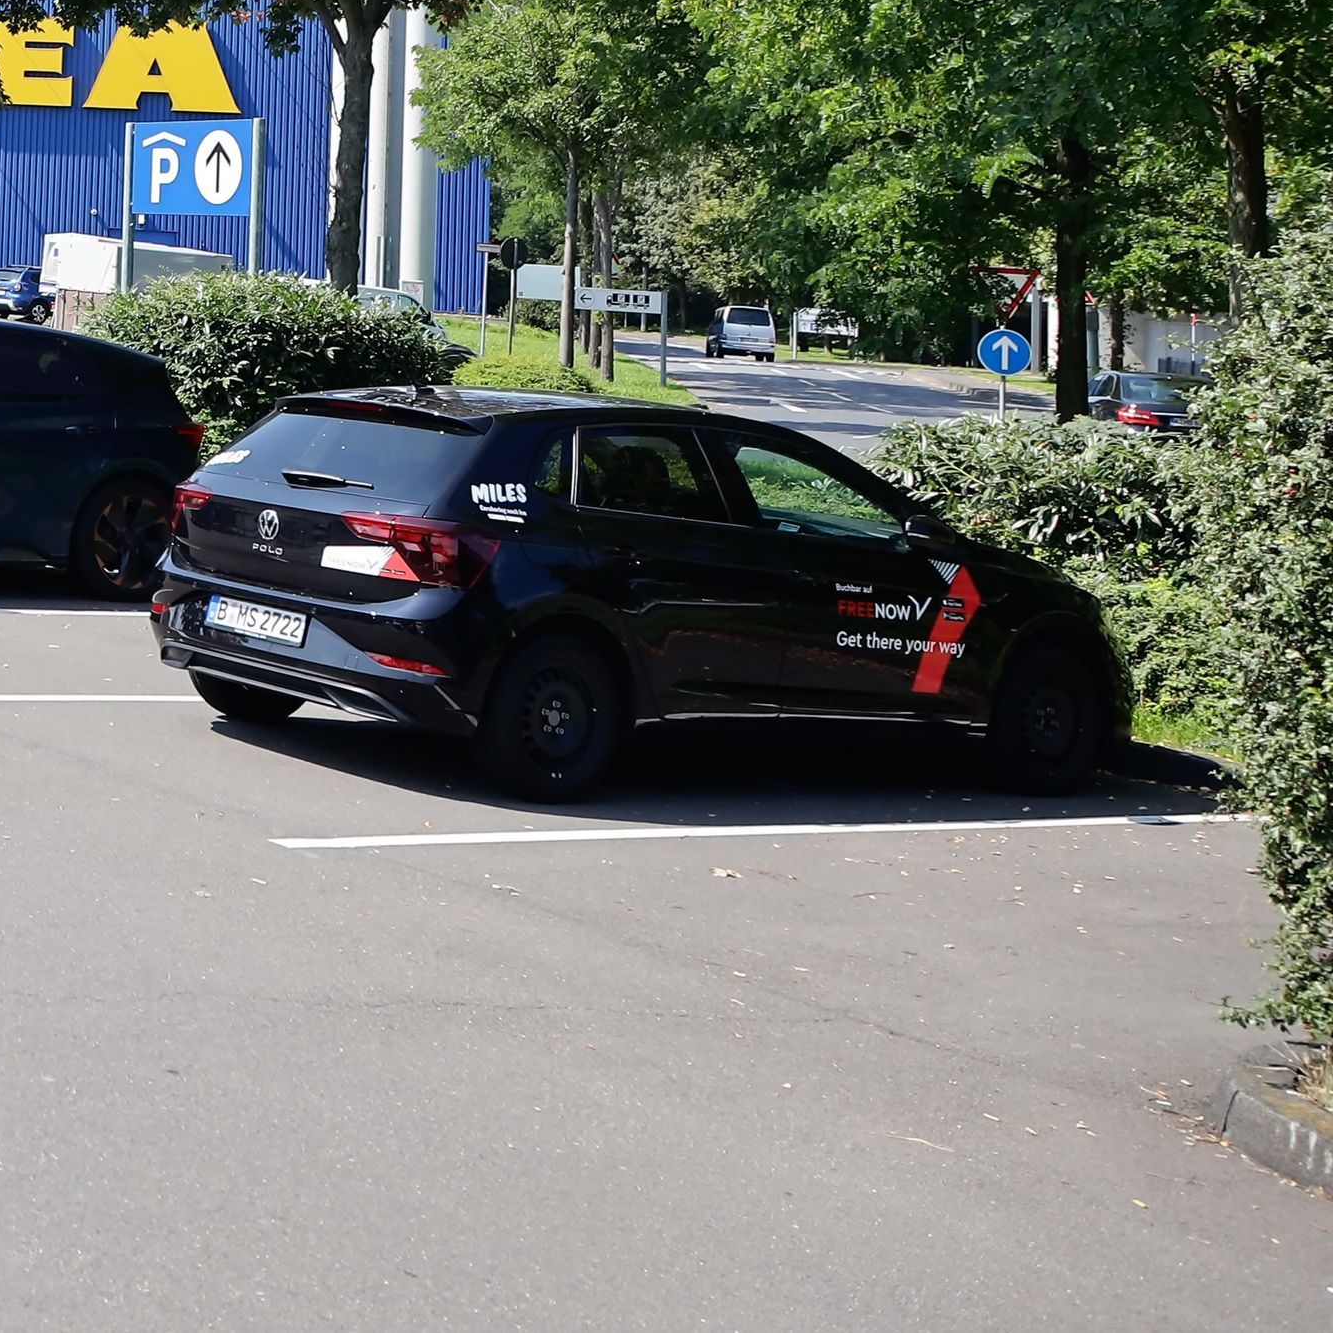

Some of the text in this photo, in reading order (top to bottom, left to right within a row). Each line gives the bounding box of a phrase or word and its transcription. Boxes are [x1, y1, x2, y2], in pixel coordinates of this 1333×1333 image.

[150, 147, 180, 204] P
[471, 483, 528, 504] MILES
[252, 542, 284, 556] POLO
[835, 583, 873, 594] Buchbar auf
[217, 601, 228, 621] B
[237, 605, 258, 629] MS
[259, 610, 303, 639] 2722
[836, 630, 966, 658] Get there your way
